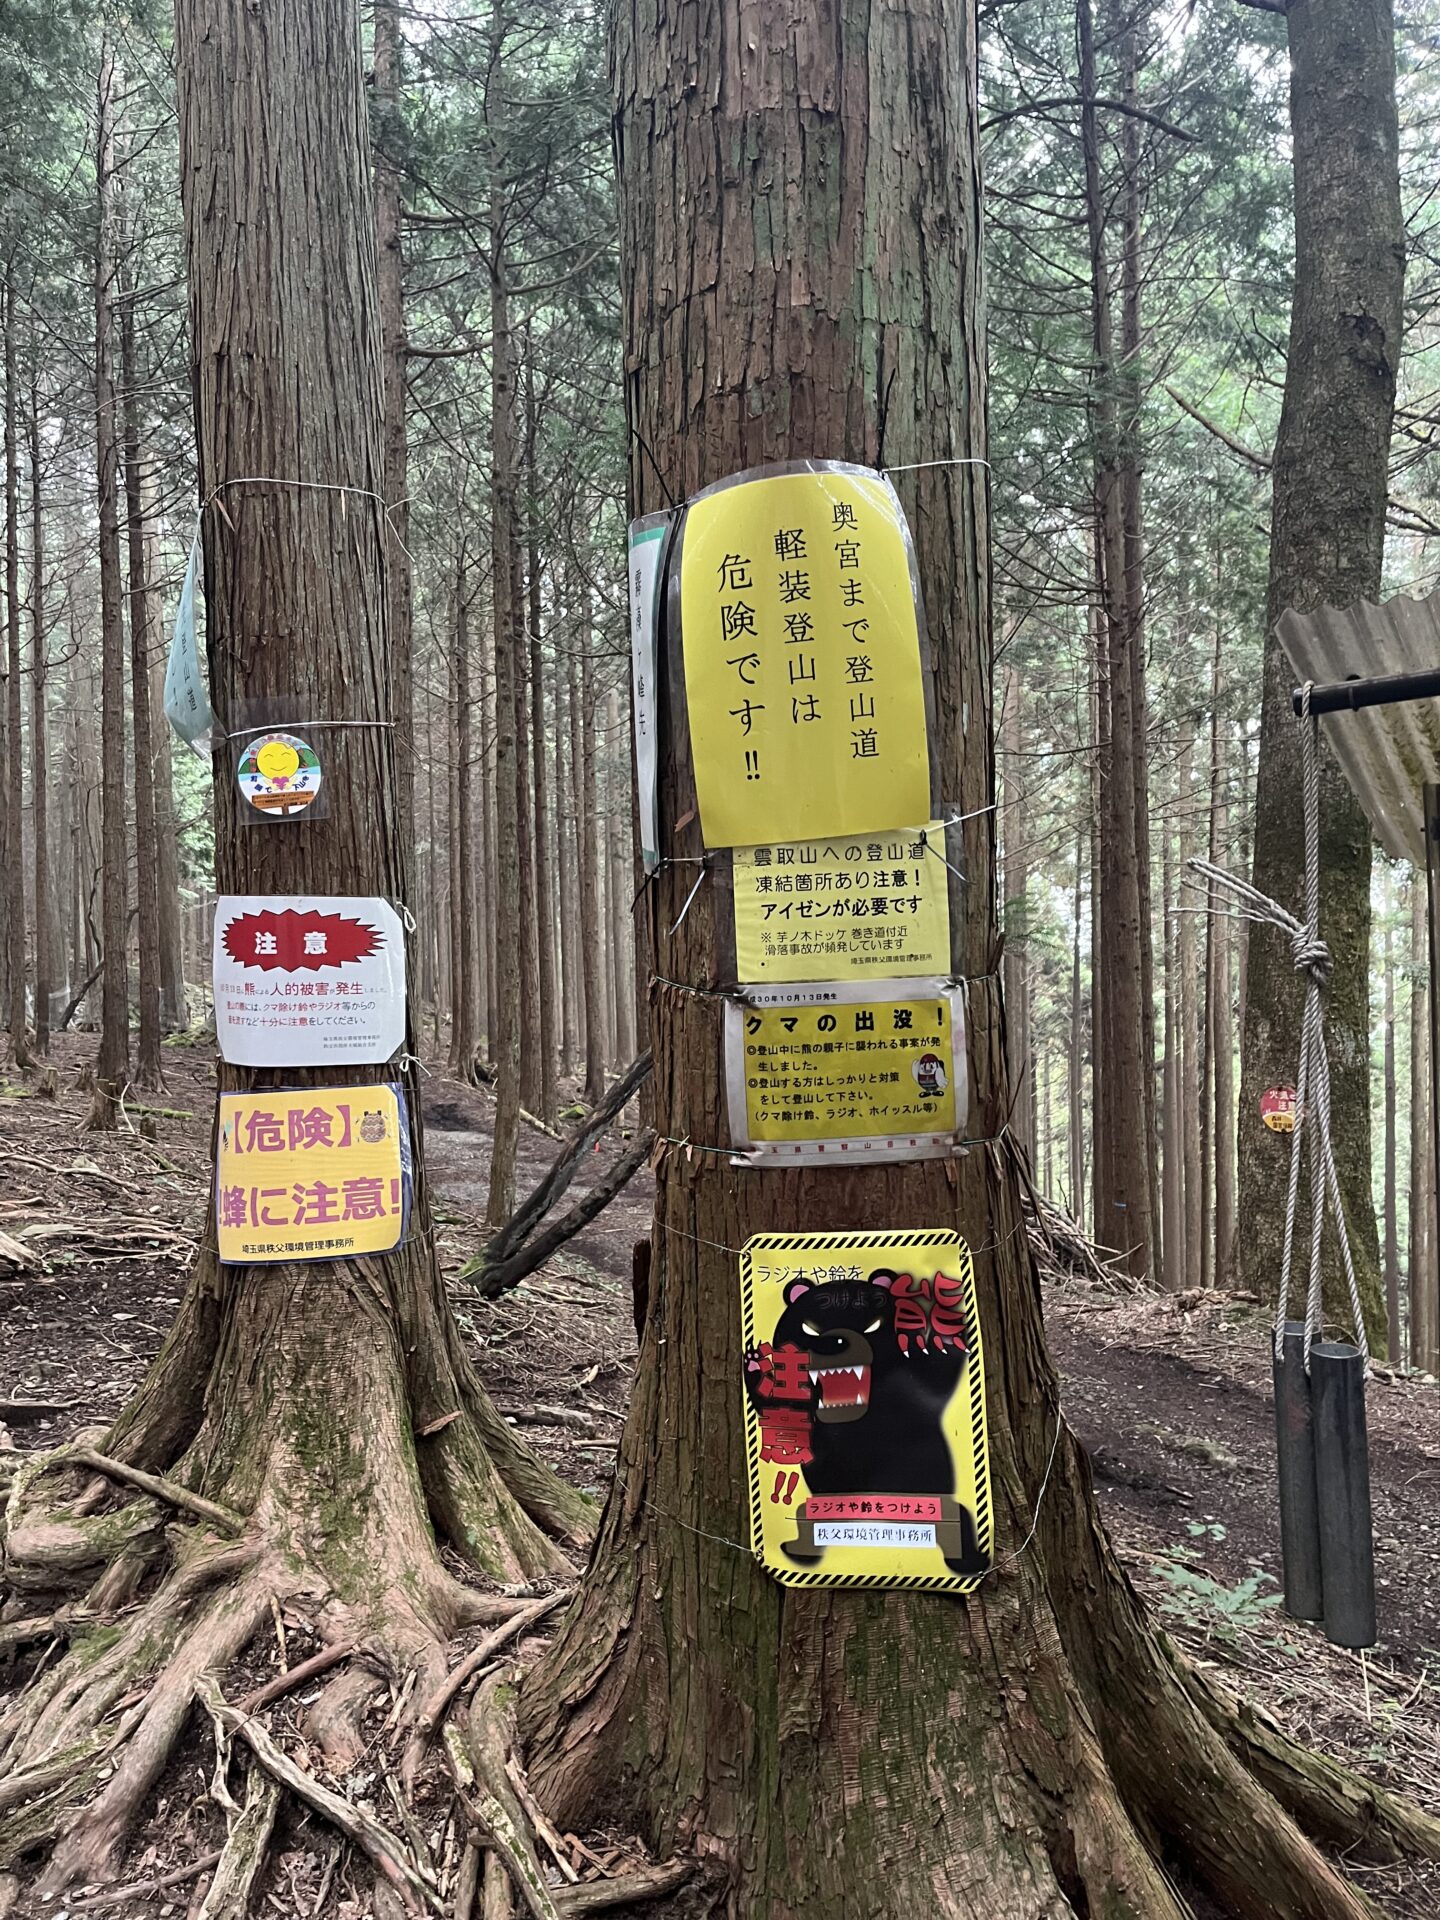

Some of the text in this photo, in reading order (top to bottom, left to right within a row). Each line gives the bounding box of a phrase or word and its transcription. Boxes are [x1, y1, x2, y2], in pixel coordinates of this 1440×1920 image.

[774, 528, 822, 724] 軽装登山は
[831, 501, 880, 759] 奥宮まで登山道
[717, 553, 766, 781] 危険です!!
[753, 842, 925, 867] 雲取山への登山道
[755, 868, 921, 893] 凍結箇所あり注意!
[760, 894, 923, 920] アイゼンが必要です
[764, 938, 905, 956] 滑落事故が頻発しています
[850, 953, 933, 965] 埼玉県秩父環境管理事務所
[749, 992, 838, 1003] 成30年10月13日発生
[745, 1007, 944, 1036] クマの出没!
[758, 1060, 819, 1073] 生しました。
[759, 1090, 874, 1106] をして登山して下さい。
[234, 1104, 352, 1154] 【危険】
[219, 1176, 401, 1228] 蜂に注意!
[241, 1237, 355, 1254] 埼玉県秩父環境管理事務所
[756, 1264, 864, 1283] ラジオや鈴を
[889, 1271, 970, 1358] 熊
[809, 1501, 938, 1514] ラジオや鈴をつけよう
[817, 1527, 932, 1542] 秩父環境管理事務所
